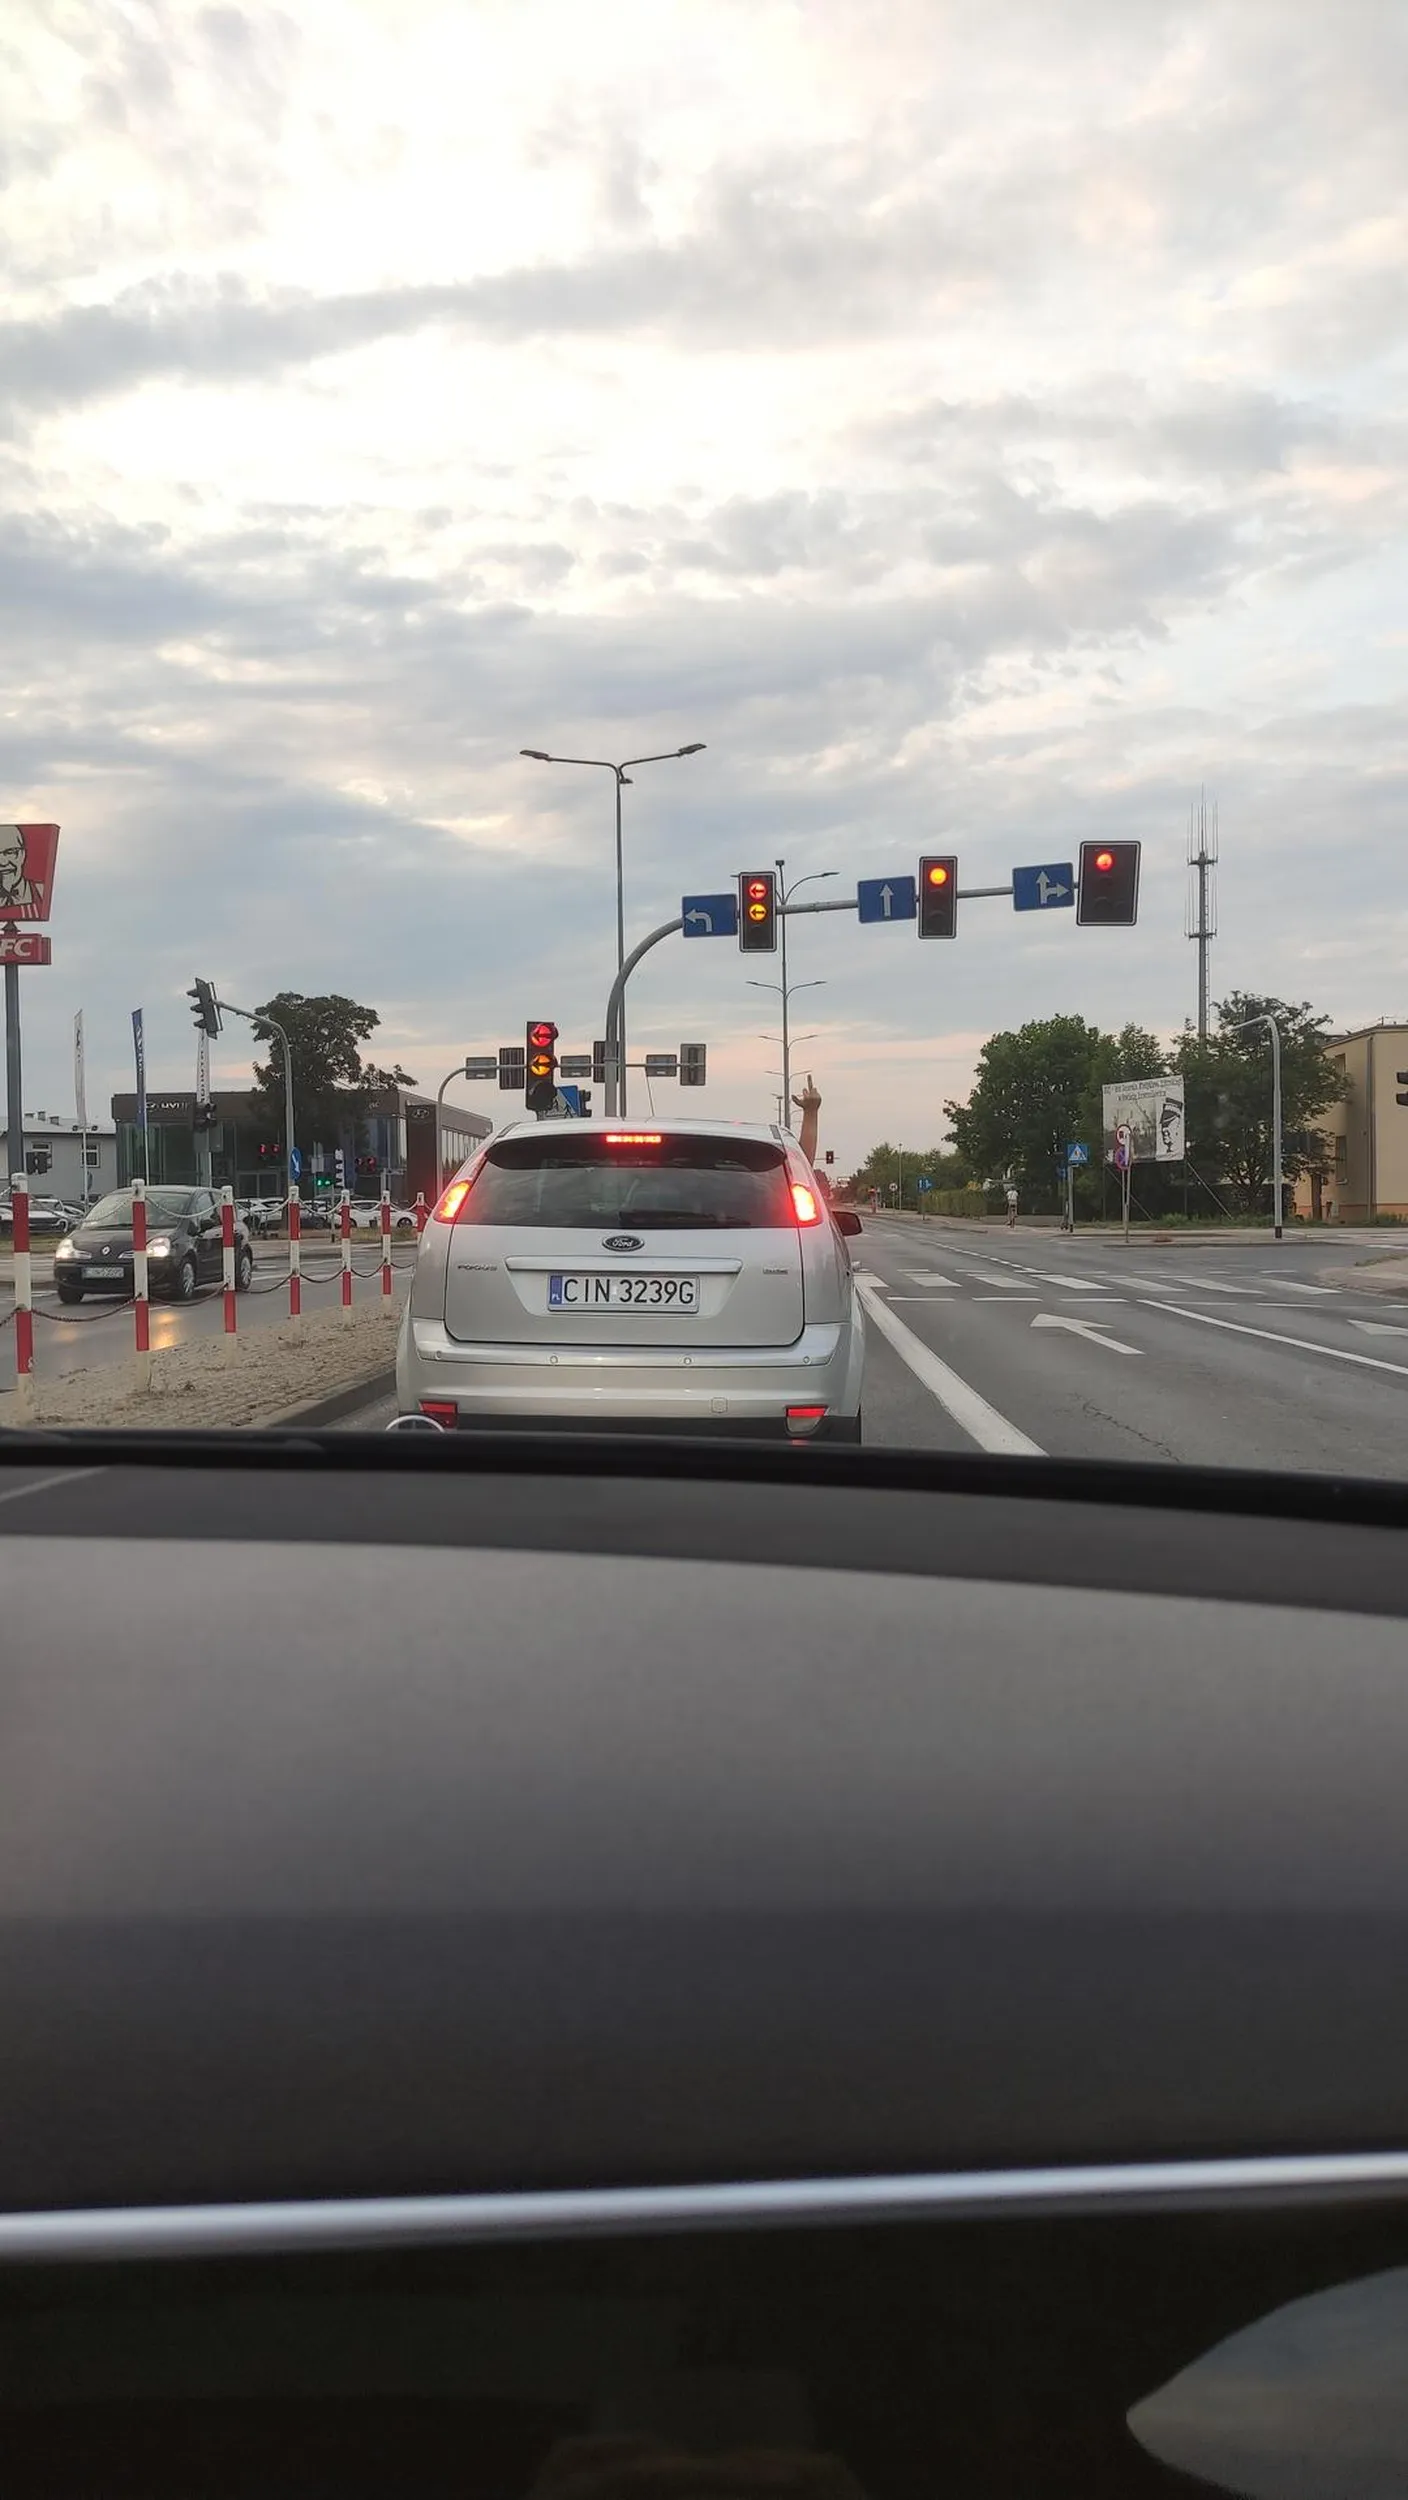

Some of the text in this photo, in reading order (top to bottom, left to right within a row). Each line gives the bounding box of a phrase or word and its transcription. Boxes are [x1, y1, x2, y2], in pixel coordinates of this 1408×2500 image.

[0, 938, 33, 957] FC
[564, 1278, 694, 1304] CIN 3239G
